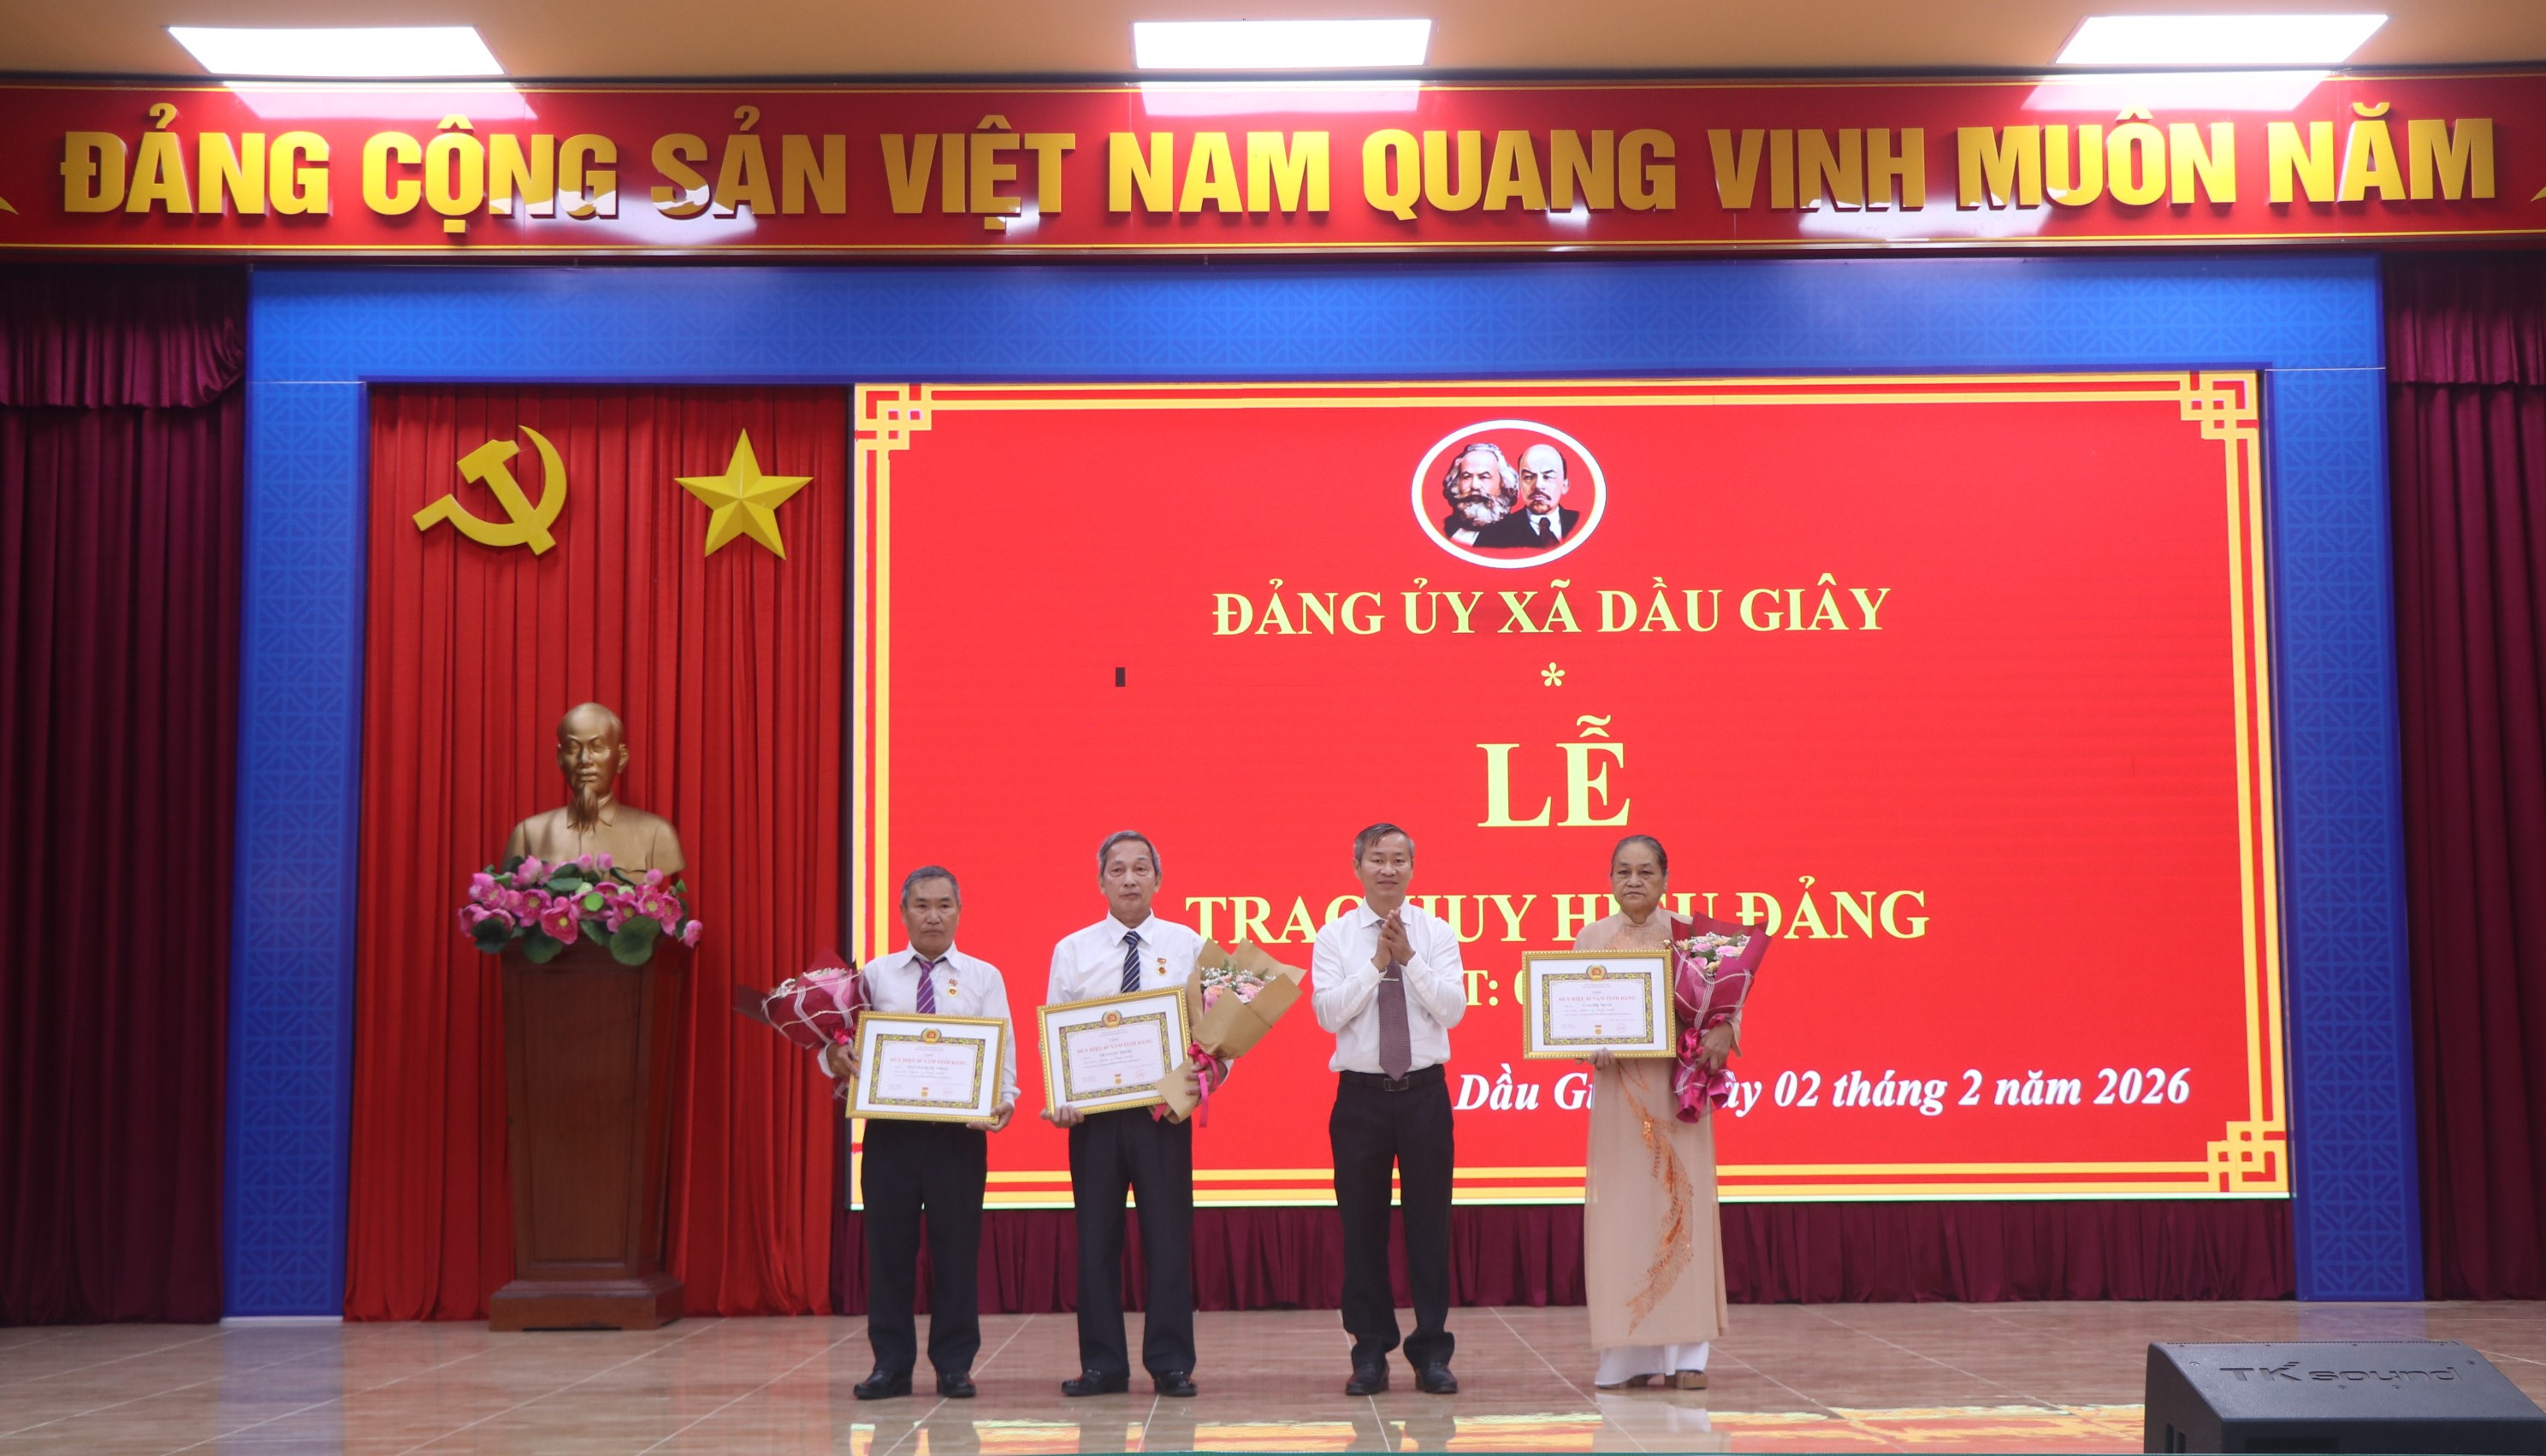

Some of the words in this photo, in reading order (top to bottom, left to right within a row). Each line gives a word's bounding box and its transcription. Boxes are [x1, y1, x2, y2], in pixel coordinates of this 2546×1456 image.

[61, 103, 329, 215] ĐẢNG
[362, 114, 617, 234] CỘNG
[650, 105, 846, 216] SẢN
[880, 115, 1075, 229] VIỆT
[1109, 131, 1329, 213] NAM
[1361, 128, 1677, 221] QUANG
[1708, 127, 1925, 211] VINH
[1956, 105, 2236, 210] MUÔN
[2266, 101, 2496, 204] NĂM
[1212, 578, 1385, 635] ĐẢNG
[1401, 577, 1483, 635] ỦY
[1498, 579, 1582, 633] XÃ
[1597, 576, 1723, 632] DẦU
[1740, 573, 1891, 631] GIÂY
[1477, 715, 1631, 827] LỄ
[1736, 875, 1930, 939] ĐẢNG
[1453, 1062, 1540, 1111] Dầu
[1773, 1070, 1822, 1107] 02
[1833, 1069, 1948, 1116] tháng
[1957, 1069, 1983, 1106] 2
[1994, 1069, 2081, 1106] năm
[2093, 1068, 2191, 1104] 2026
[2220, 1361, 2302, 1382] TK
[2308, 1366, 2462, 1382] sound
